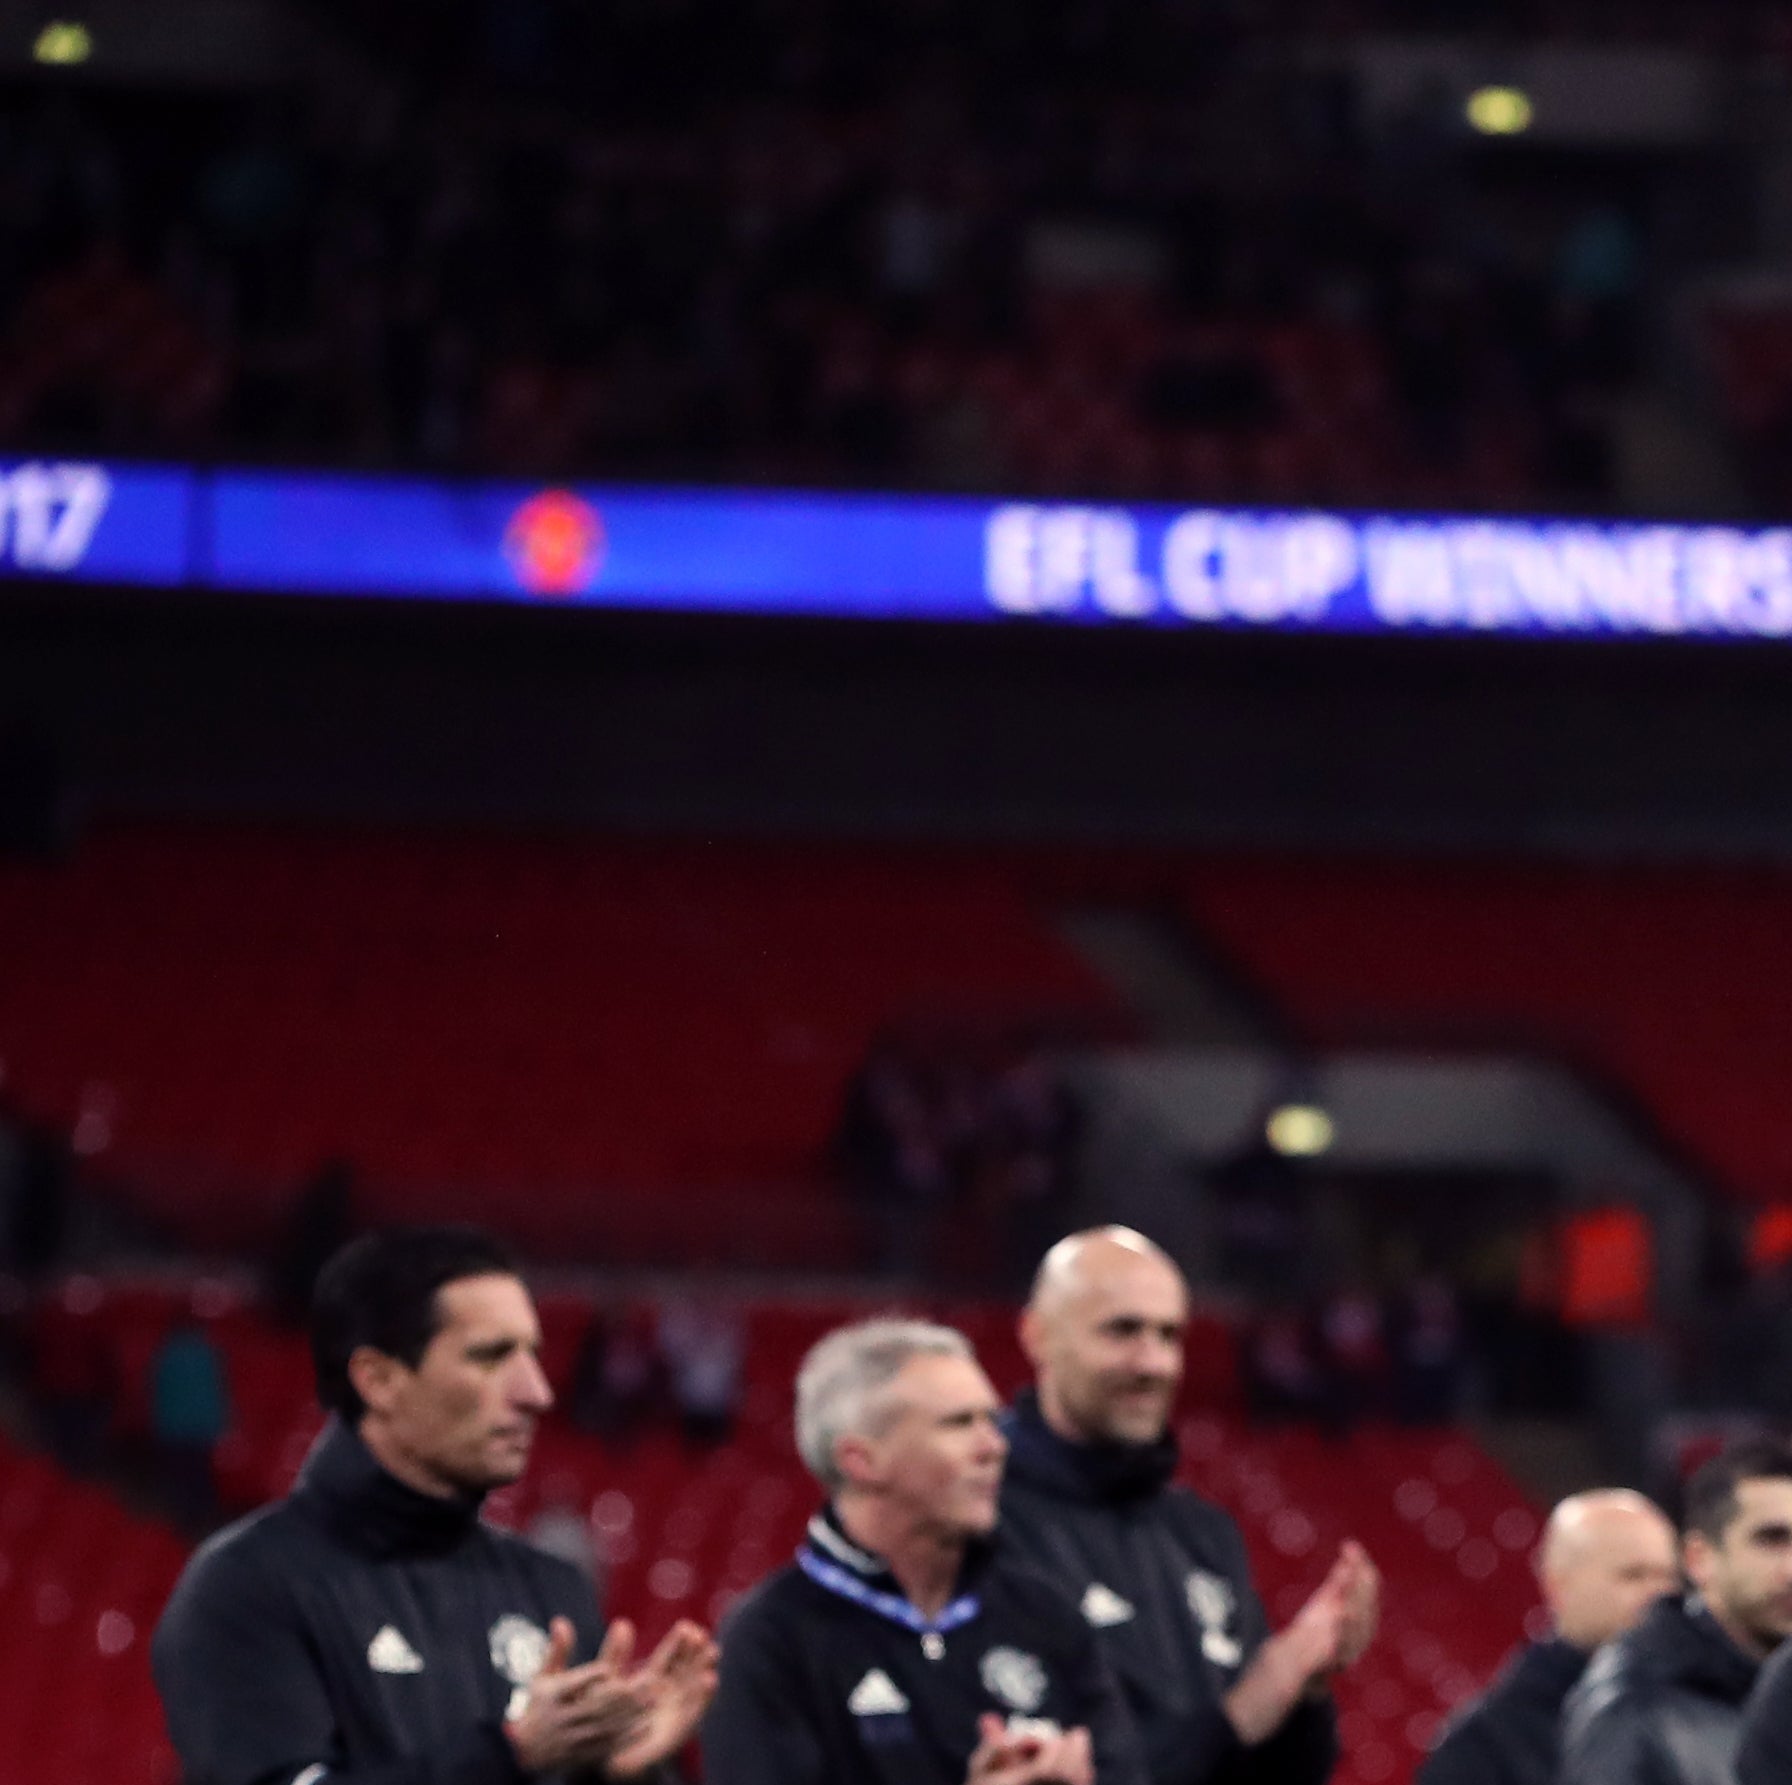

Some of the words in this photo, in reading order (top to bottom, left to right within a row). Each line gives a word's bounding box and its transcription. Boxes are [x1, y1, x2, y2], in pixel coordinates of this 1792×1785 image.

[0, 462, 110, 573] 17
[984, 502, 1158, 620] EFL
[1162, 508, 1360, 623] CUP
